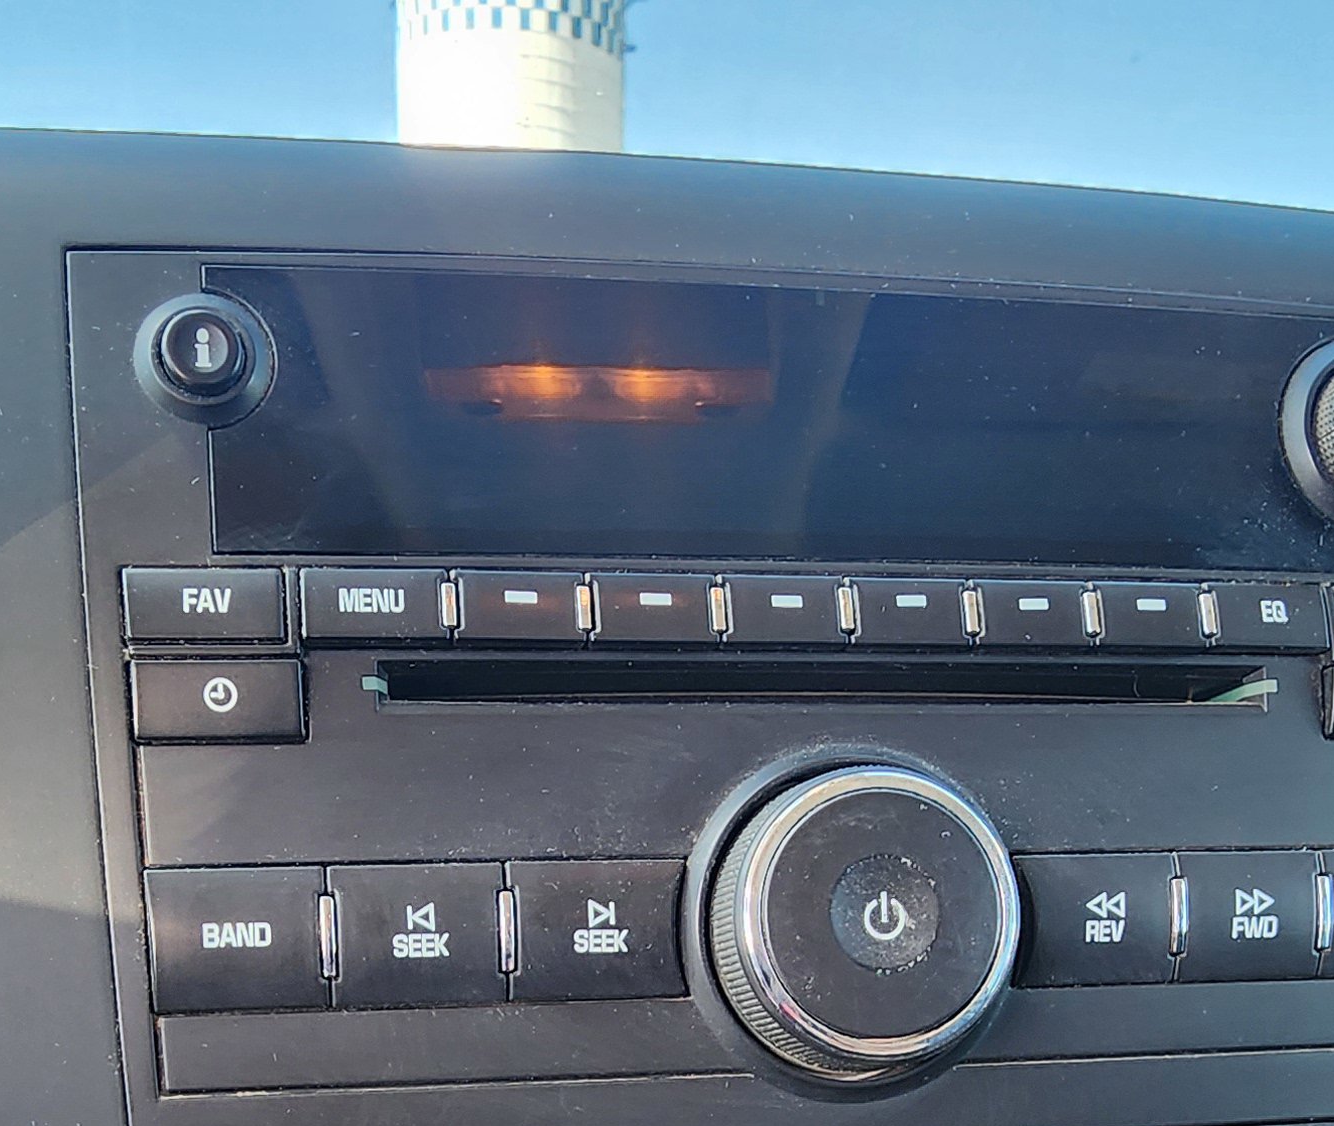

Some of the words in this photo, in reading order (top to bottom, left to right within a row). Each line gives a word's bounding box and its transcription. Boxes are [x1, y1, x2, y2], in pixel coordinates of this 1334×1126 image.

[182, 587, 231, 614] FAV
[338, 587, 405, 614] MENU
[1260, 600, 1289, 624] EQ
[201, 921, 272, 949] BAND
[1085, 919, 1126, 943] REV
[1231, 914, 1279, 940] FWD
[391, 931, 451, 959] SEEK
[572, 927, 629, 955] SEEK
